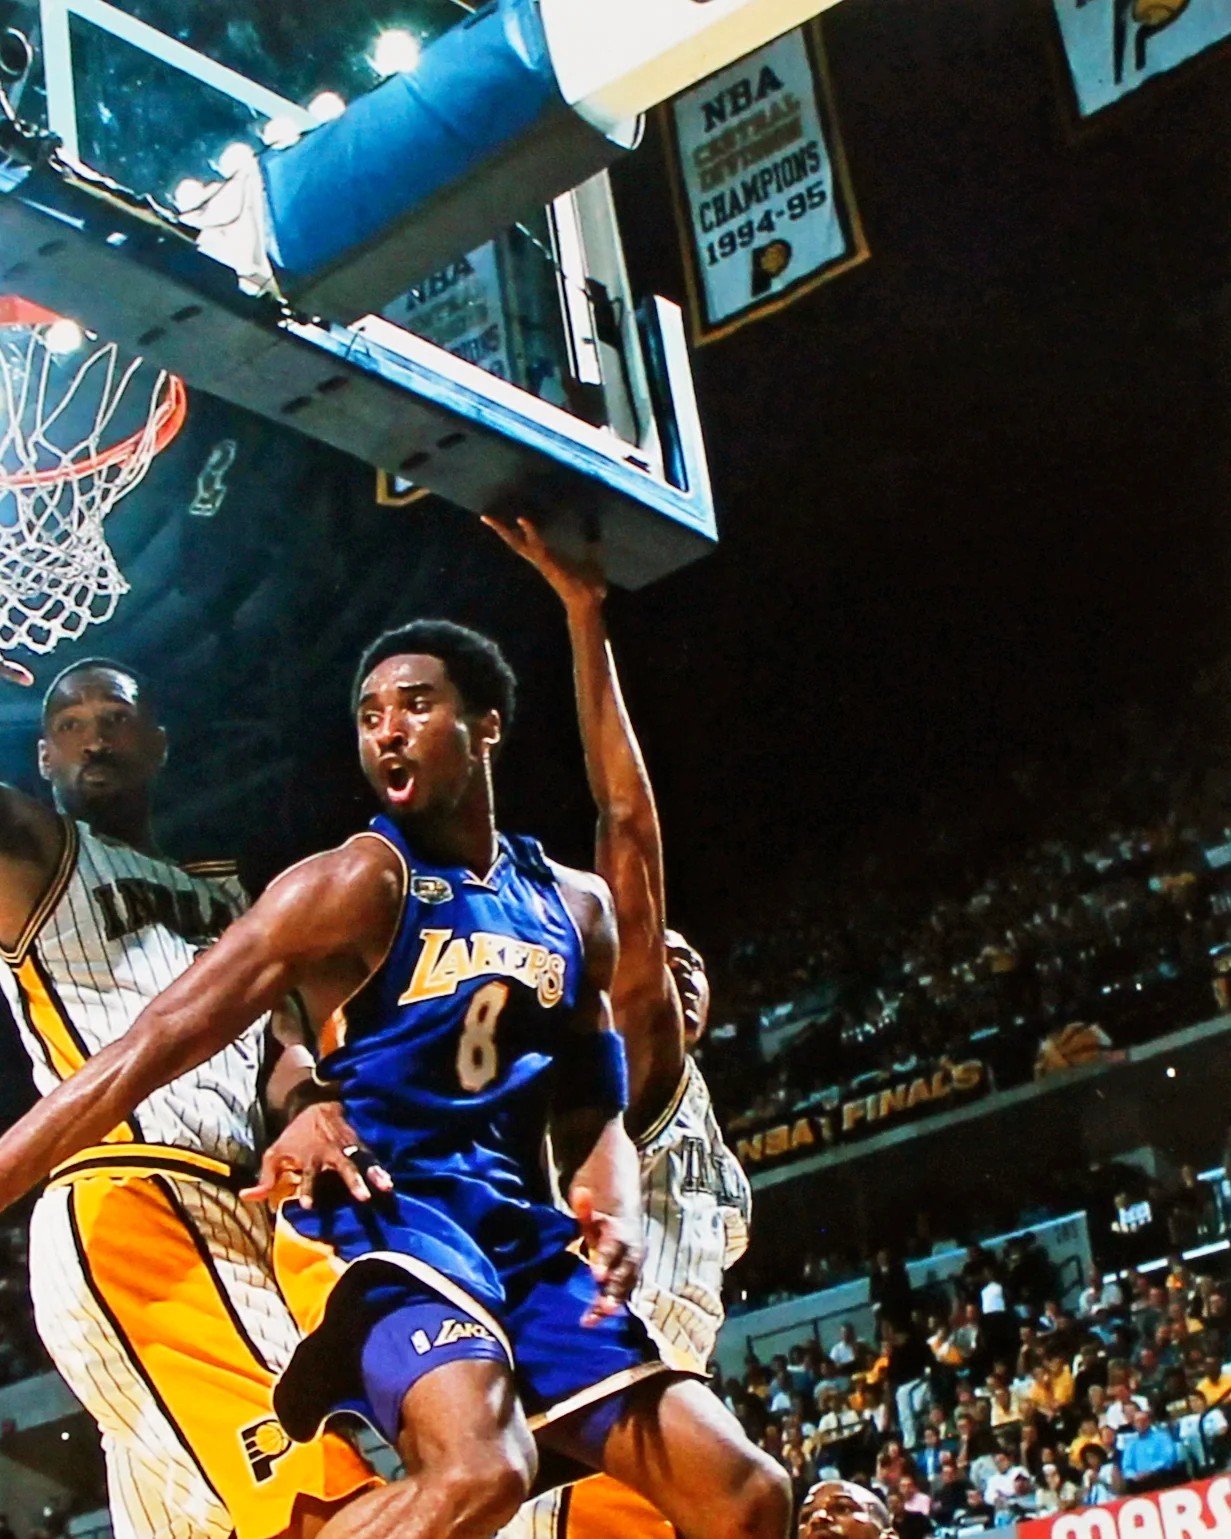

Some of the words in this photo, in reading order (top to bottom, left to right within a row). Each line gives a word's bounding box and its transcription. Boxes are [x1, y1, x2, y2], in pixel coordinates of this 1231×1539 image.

[703, 65, 785, 133] NBA
[698, 140, 823, 235] CHAMPIONS
[706, 180, 828, 267] 1994-95
[397, 928, 566, 1008] LAKERS
[456, 981, 510, 1092] 8
[841, 1056, 984, 1132] FINALS
